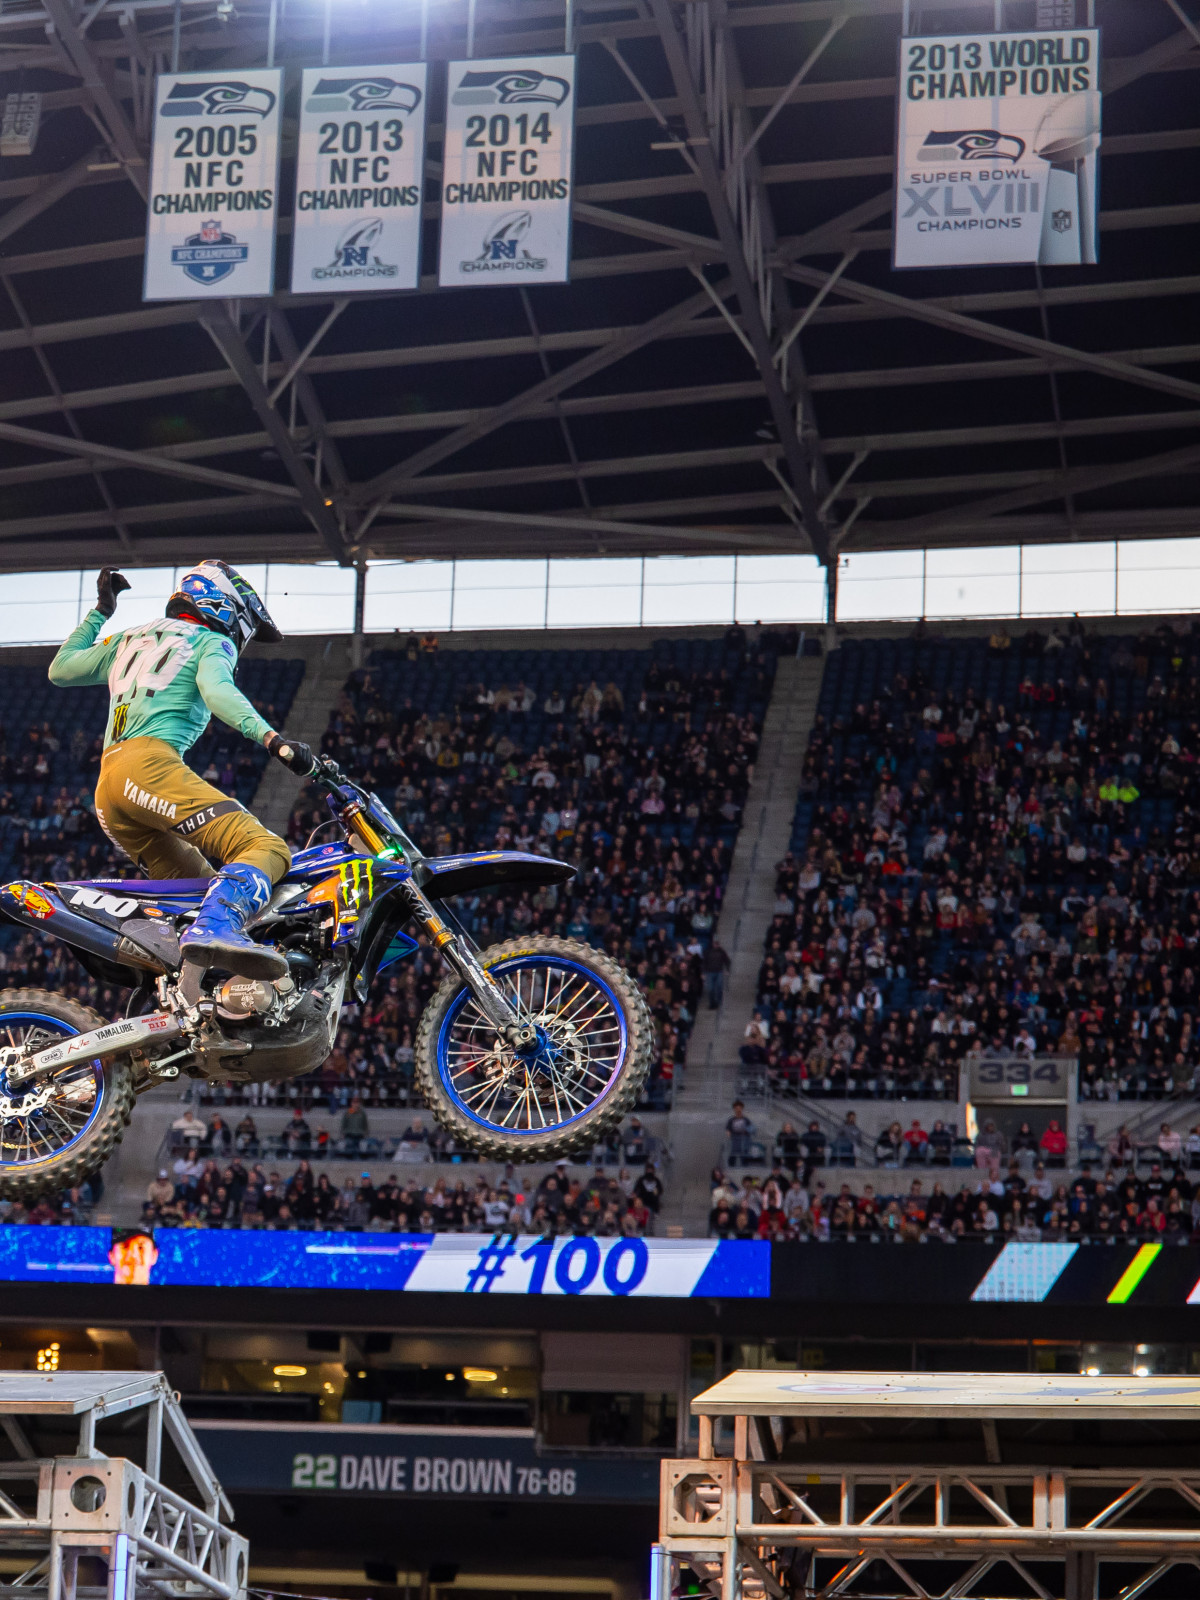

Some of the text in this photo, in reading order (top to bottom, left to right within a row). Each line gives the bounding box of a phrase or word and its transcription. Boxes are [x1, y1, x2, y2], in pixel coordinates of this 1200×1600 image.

[908, 37, 1090, 72] 2013 WORLD
[907, 66, 1089, 101] CHAMPIONS
[174, 125, 257, 158] 2005
[319, 119, 402, 154] 2013
[466, 112, 551, 147] 2014
[184, 161, 243, 188] NFC
[330, 156, 389, 184] NFC
[477, 149, 537, 177] NFC
[910, 170, 1031, 184] SUPER BOWL
[153, 190, 272, 214] CHAMPIONS
[298, 186, 419, 210] CHAMPIONS
[445, 179, 568, 203] CHAMPIONS
[903, 183, 1040, 218] XLVIII
[917, 218, 1022, 232] CHAMPIONS
[315, 267, 396, 279] CHAMPIONS
[462, 260, 545, 273] CHAMPIONS
[123, 778, 176, 820] YAMAHA
[177, 806, 216, 835] THOR
[69, 888, 139, 918] 100
[95, 1023, 135, 1040] YAMALUBE
[978, 1063, 1060, 1083] 334
[464, 1234, 649, 1296] #100
[293, 1453, 576, 1496] 22 DAVE BROWN 76-86
